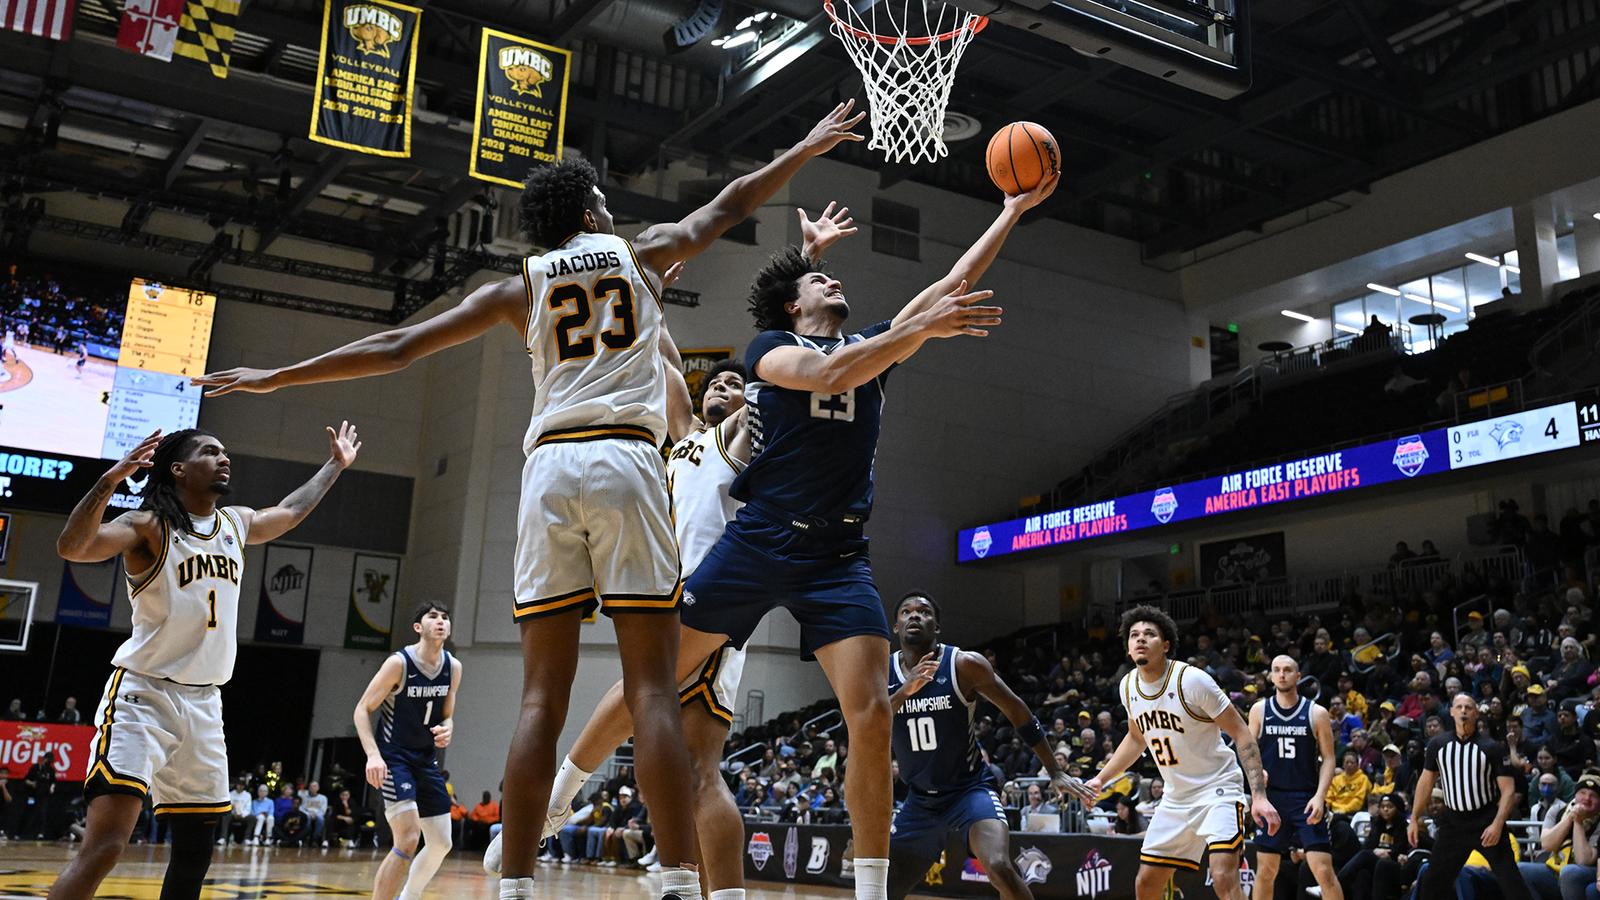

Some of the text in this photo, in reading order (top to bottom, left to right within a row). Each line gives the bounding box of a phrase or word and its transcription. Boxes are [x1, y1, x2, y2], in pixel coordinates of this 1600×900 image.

[347, 7, 400, 38] UMBC
[332, 53, 400, 78] VOLLEYBALL
[501, 48, 550, 78] UMBC
[331, 68, 401, 92] AMERICA EAST
[323, 99, 349, 113] 2020
[352, 106, 376, 119] 2021
[337, 89, 392, 110] CHAMPIONS
[488, 94, 554, 116] VOLLEYBALL
[488, 108, 553, 130] AMERICA EAST
[491, 118, 548, 139] CONFERENCE
[481, 137, 556, 162] 2020 2021 2022
[493, 128, 545, 148] CHAMPIONS
[480, 149, 504, 162] 2023
[546, 251, 621, 279] JACOBS
[187, 290, 203, 306] 18
[548, 276, 638, 362] 23
[175, 381, 185, 393] 4
[1544, 404, 1599, 440] 4 11
[1453, 431, 1461, 444] 0
[1584, 429, 1600, 441] HA
[1455, 449, 1463, 463] 3
[1221, 452, 1343, 494] AIR FORCE RESERVE
[1205, 467, 1360, 514] AMERICA EAST PLAYOFFS
[792, 520, 809, 530] UNH
[1025, 500, 1116, 533] AIR FORCE RESERVE
[1012, 514, 1128, 550] AMERICA EAST PLAYOFFS
[178, 553, 238, 588] UMBC
[207, 589, 217, 628] 1
[407, 685, 450, 698] NEW HAMPSHIRE
[423, 701, 433, 725] 1
[905, 695, 952, 714] HAMPSHIRE
[906, 716, 938, 752] 10
[1135, 710, 1185, 735] UMBC
[1265, 725, 1307, 736] NEW HAMPSHIRE
[0, 740, 72, 772] IGH'S
[1151, 736, 1179, 766] 21
[1277, 737, 1296, 759] 15
[1076, 866, 1112, 900] NJIT
